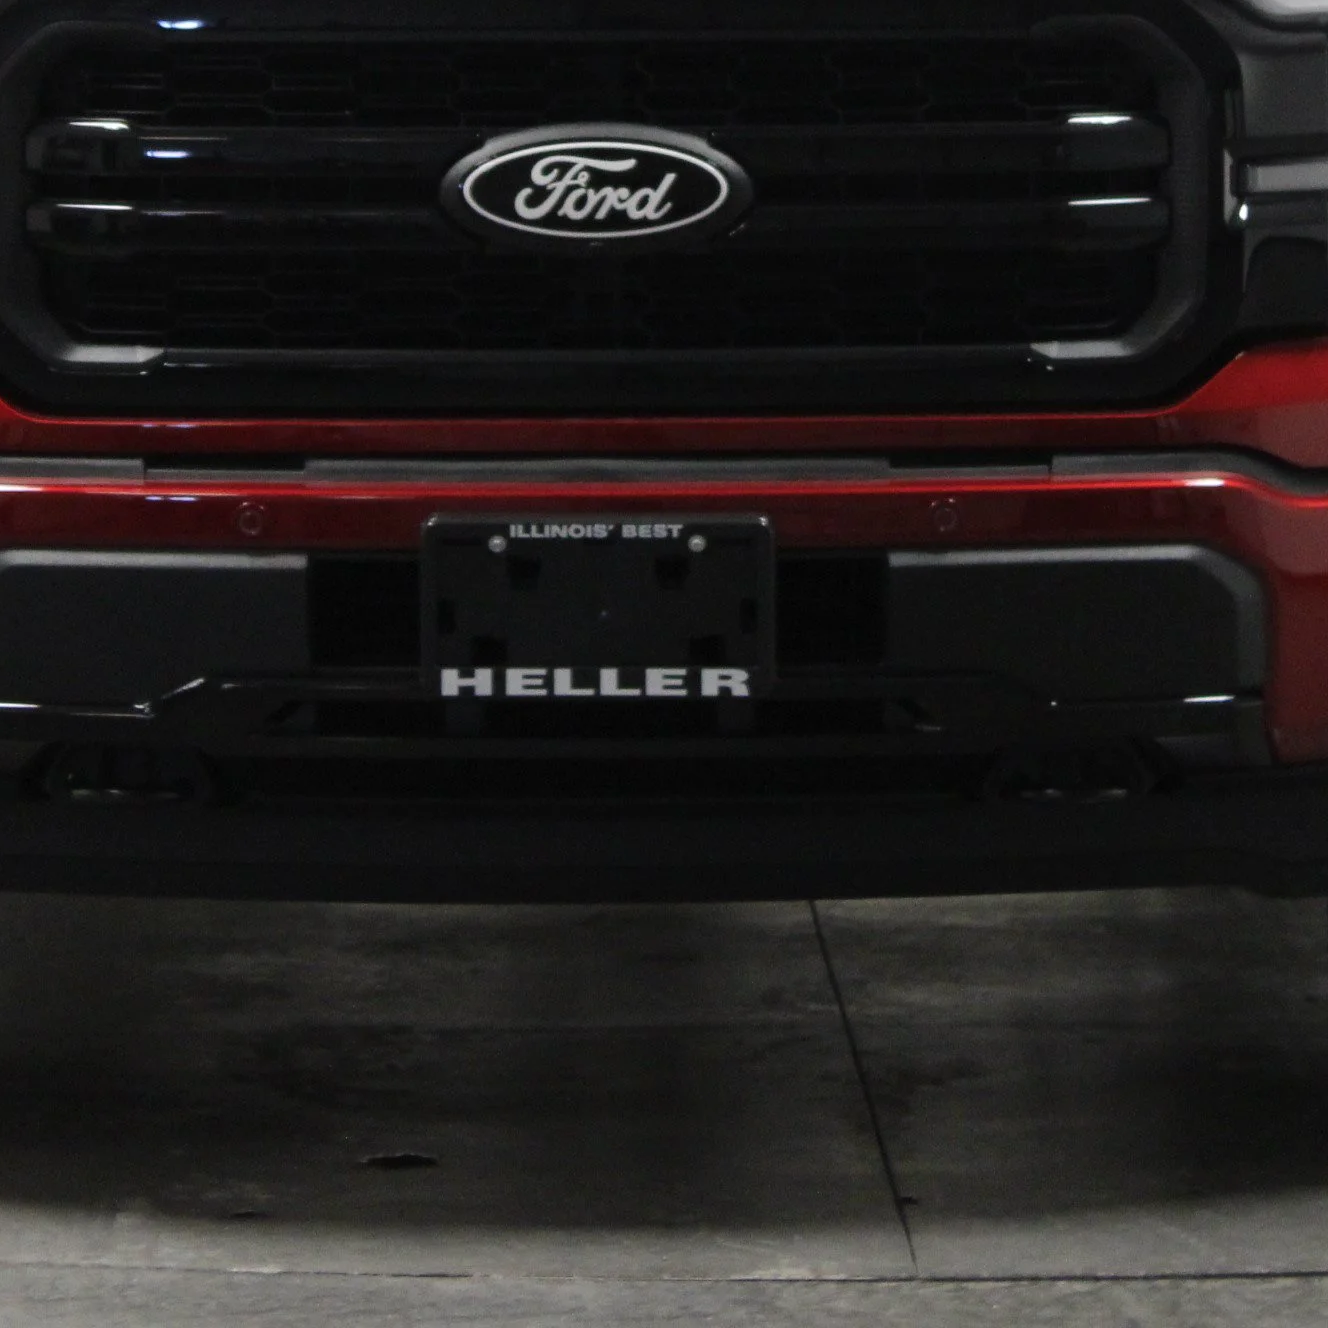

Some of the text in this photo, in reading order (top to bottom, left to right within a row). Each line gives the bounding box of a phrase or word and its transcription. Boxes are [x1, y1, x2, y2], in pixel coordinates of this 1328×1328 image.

[514, 155, 677, 220] Ford
[509, 523, 684, 539] ILLINOIS' BEST
[440, 668, 750, 697] HELLER
